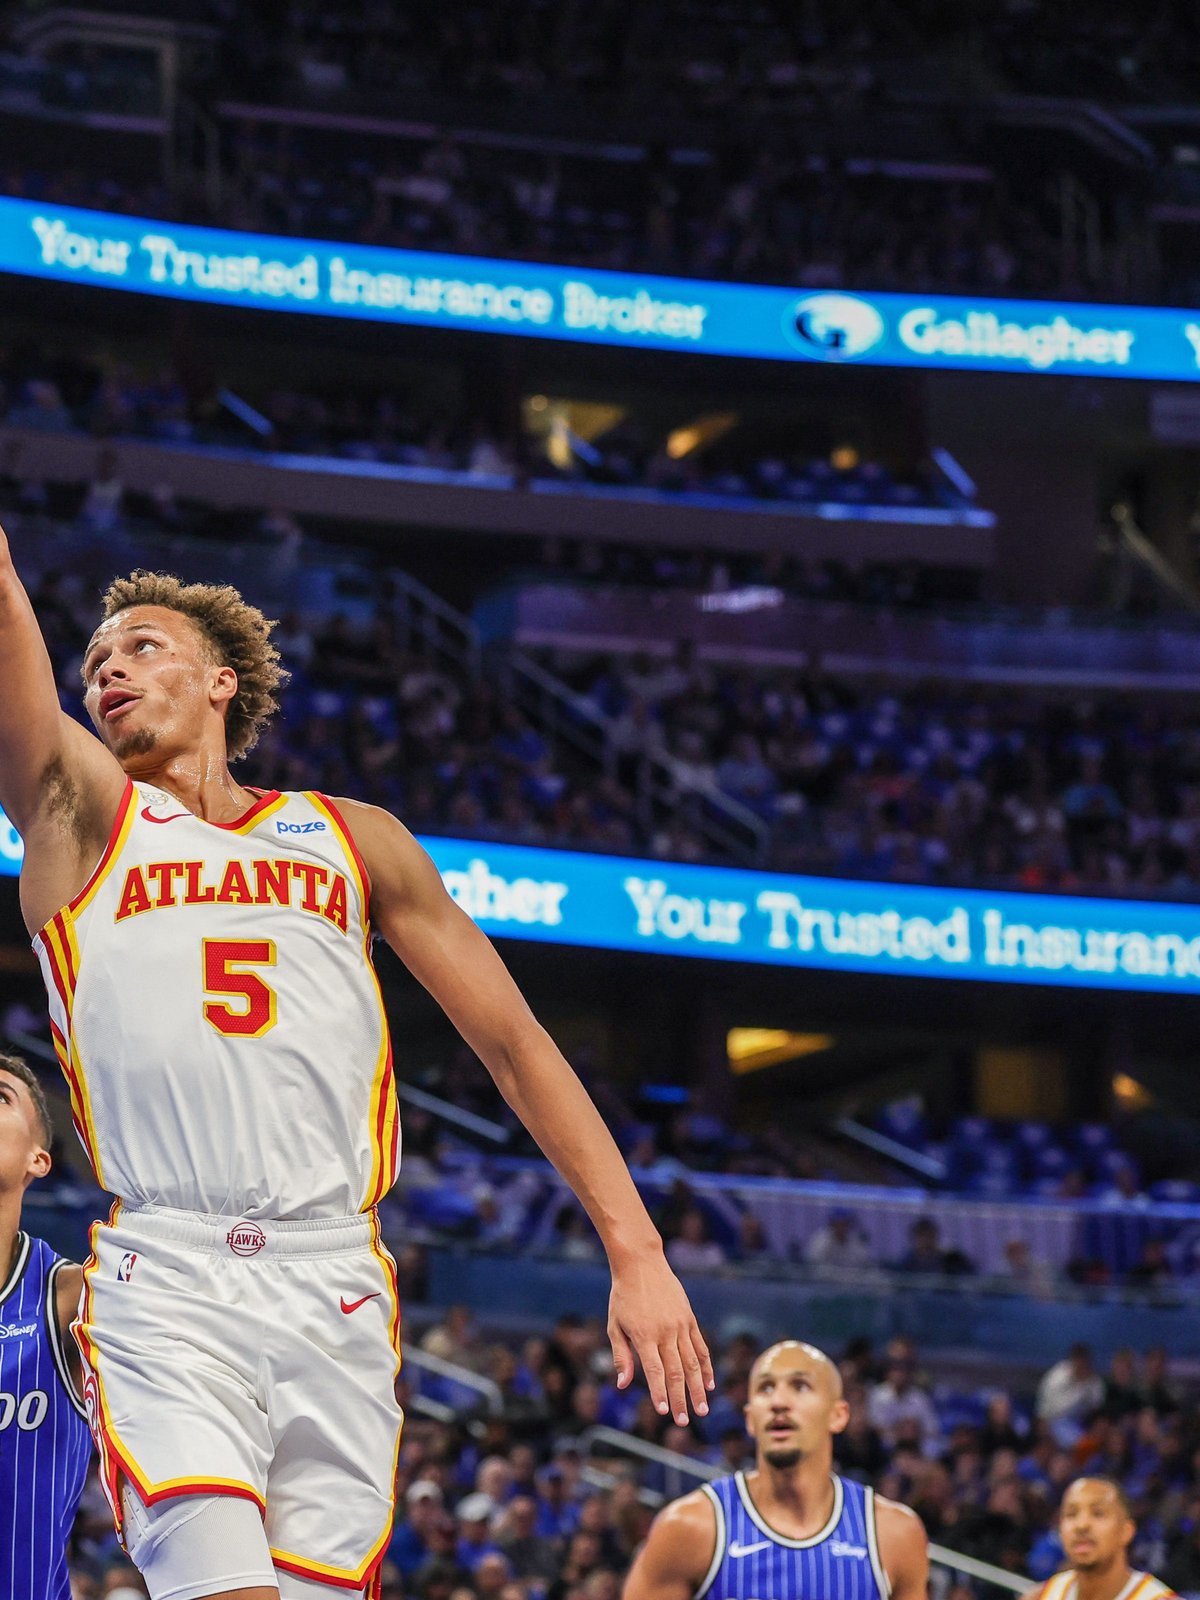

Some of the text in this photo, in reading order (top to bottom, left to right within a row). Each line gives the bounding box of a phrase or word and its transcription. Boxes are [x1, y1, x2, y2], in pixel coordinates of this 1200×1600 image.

[31, 216, 707, 340] Your Trusted Insurance Broker
[900, 307, 1135, 370] Gallagher
[276, 821, 327, 834] paze
[114, 859, 349, 936] ATLANTA
[624, 876, 747, 946] Your
[756, 889, 971, 963] Trusted
[202, 937, 277, 1038] 5
[226, 1232, 266, 1247] HAWKS
